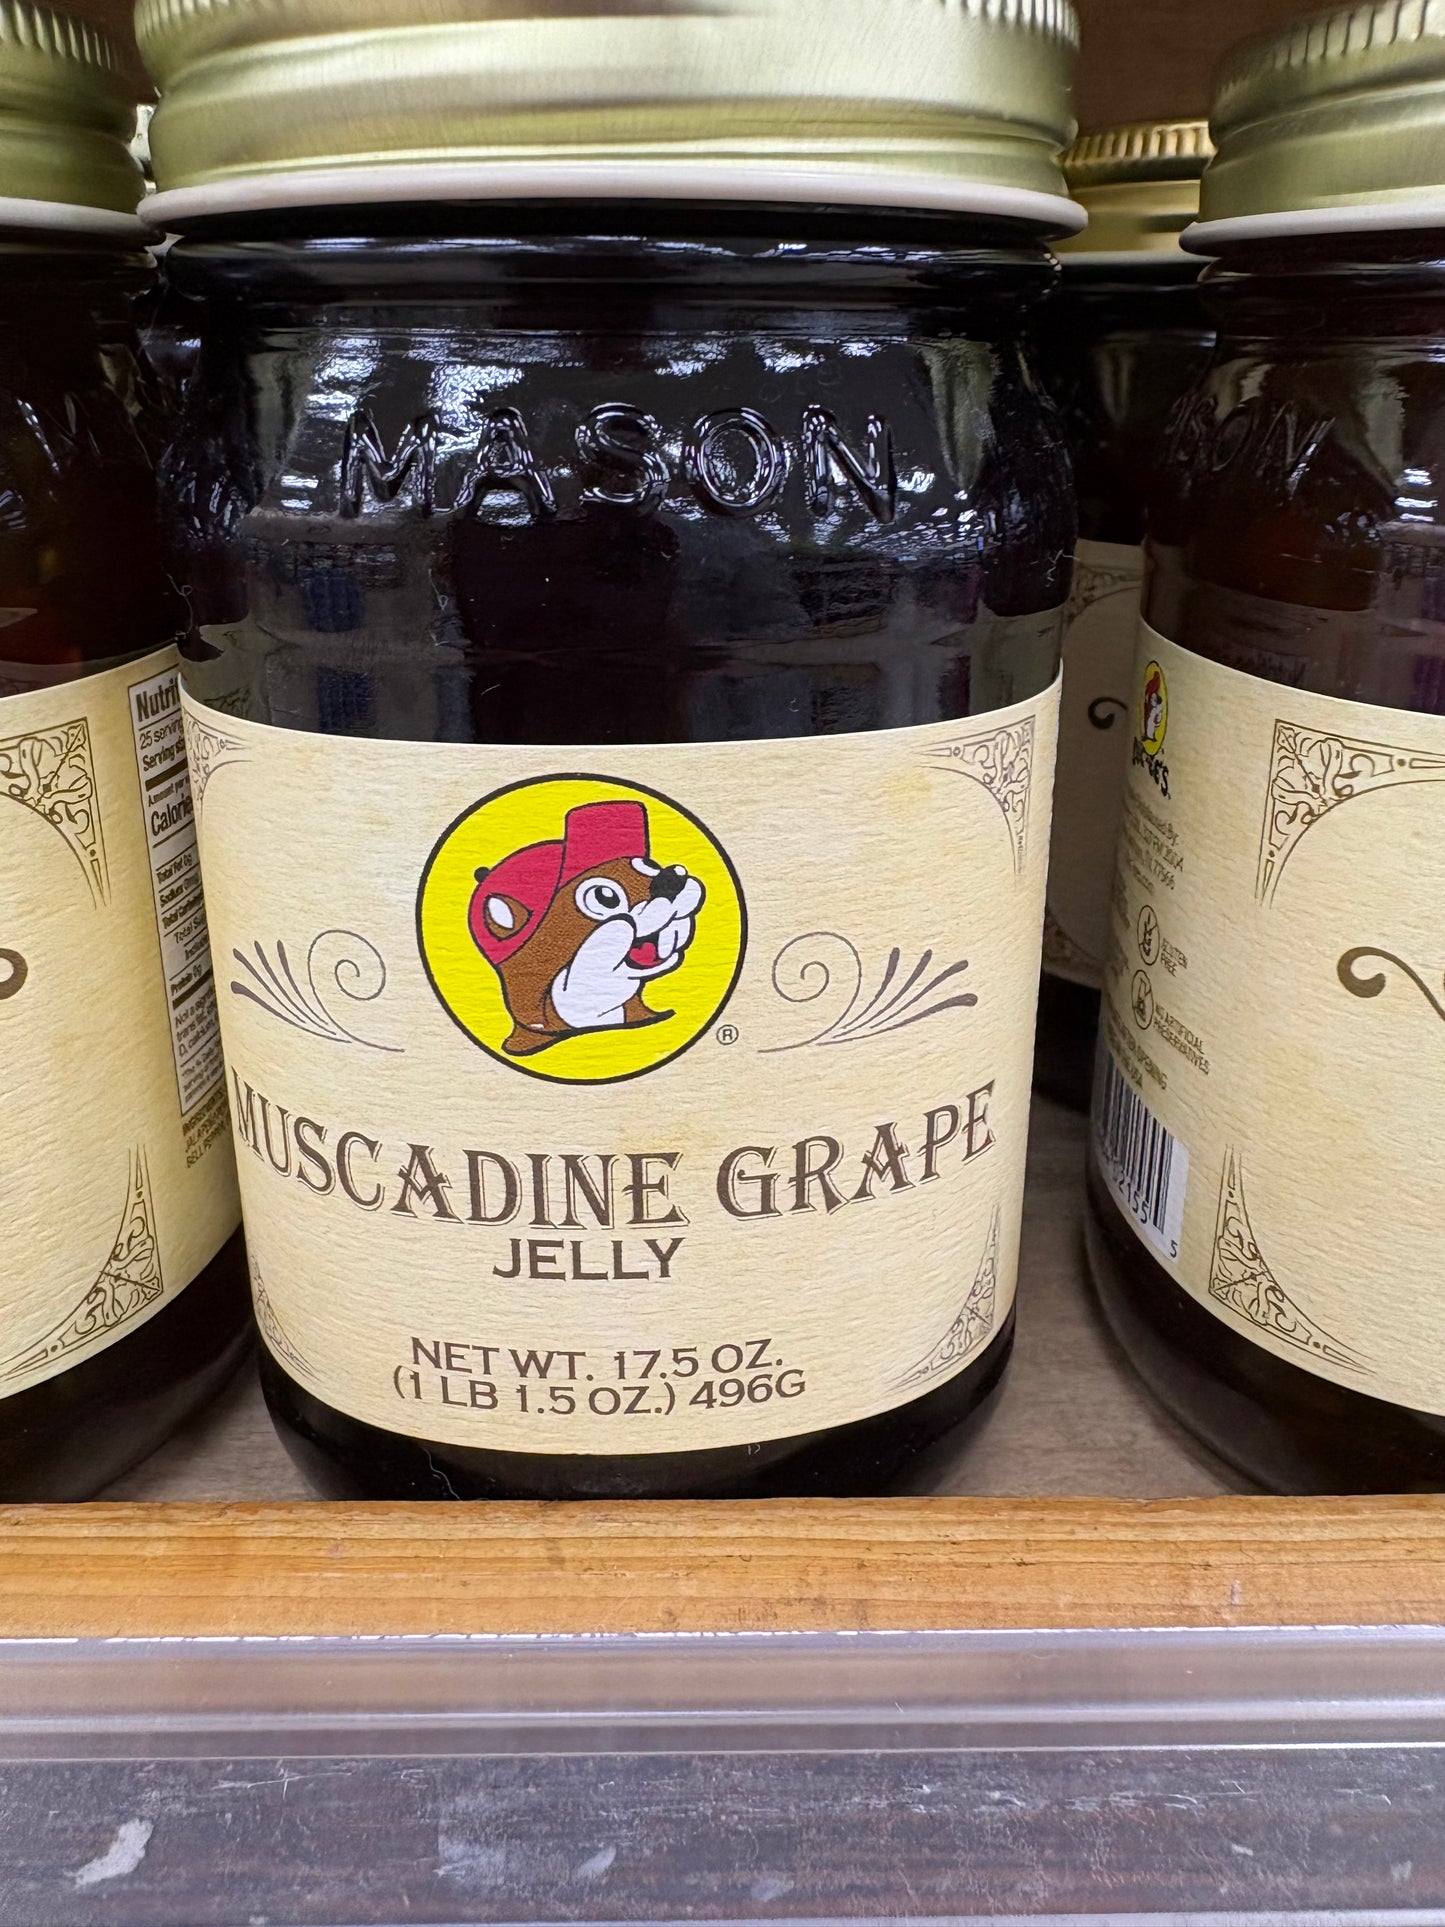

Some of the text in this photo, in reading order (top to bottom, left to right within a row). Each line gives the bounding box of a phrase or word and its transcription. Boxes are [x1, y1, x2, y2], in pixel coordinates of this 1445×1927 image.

[339, 404, 897, 524] MASON
[140, 730, 153, 750] 25
[231, 1065, 997, 1231] MUSCADINE GRAPE
[493, 1237, 687, 1282] JELLY
[410, 1336, 784, 1382] NET WT. 17.5 OZ.
[393, 1365, 807, 1417] (1 LB 1.5 OZ.) 496G
